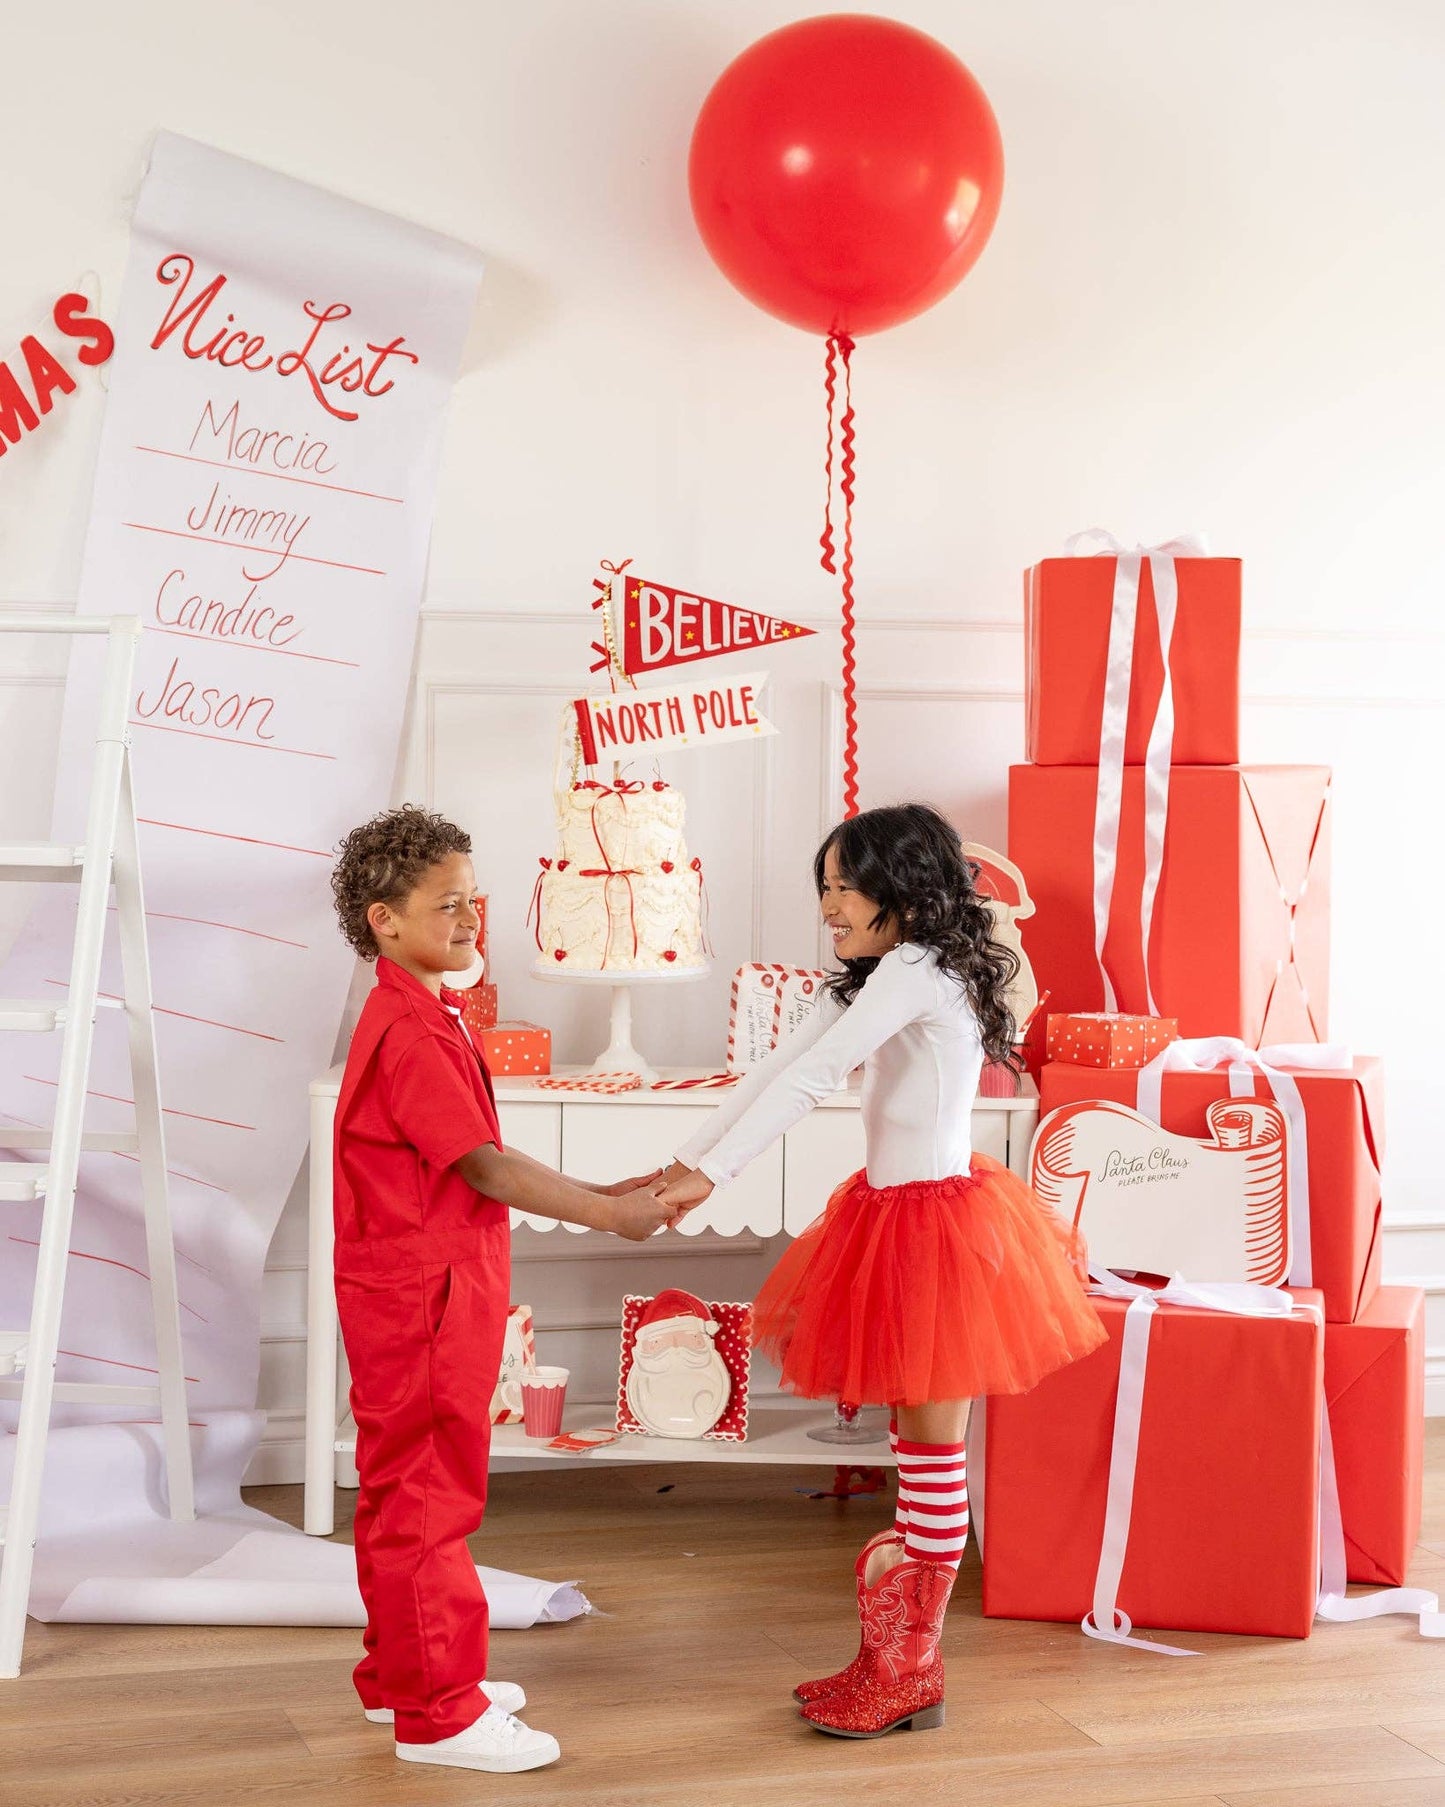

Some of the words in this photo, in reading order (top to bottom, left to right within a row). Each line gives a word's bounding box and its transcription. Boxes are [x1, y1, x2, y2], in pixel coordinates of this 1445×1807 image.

[150, 253, 273, 372] Nice
[276, 300, 419, 421] List
[189, 399, 339, 474] Marcia
[187, 481, 311, 582] Jimmy
[156, 569, 304, 646] Candice
[638, 586, 784, 664] BELIEVE
[136, 657, 275, 739] Jason
[595, 696, 685, 748] NORTH
[692, 685, 759, 735] POLE
[1098, 1150, 1145, 1182] Santa
[1148, 1146, 1189, 1170] Claus
[1118, 1175, 1145, 1187] PLEASE
[1147, 1173, 1169, 1183] BRING
[1170, 1172, 1180, 1180] ME
